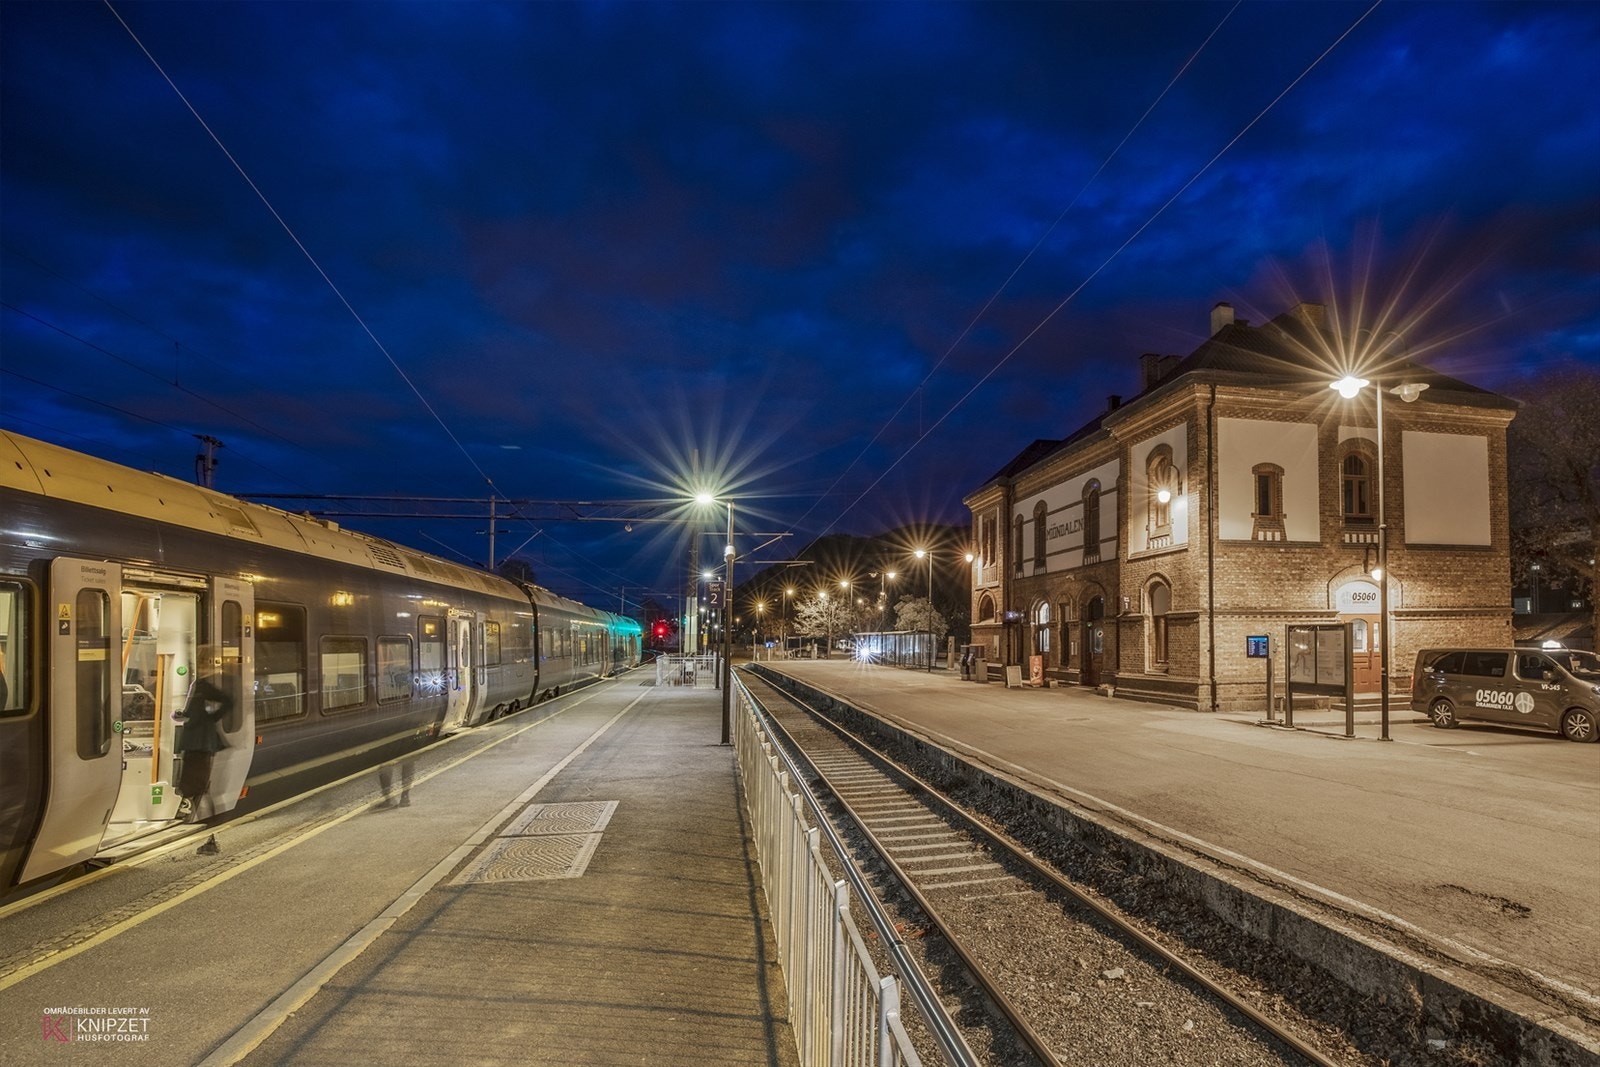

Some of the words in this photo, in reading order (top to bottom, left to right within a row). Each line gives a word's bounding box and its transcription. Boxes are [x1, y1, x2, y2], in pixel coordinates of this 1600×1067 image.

[710, 593, 718, 604] 2
[1352, 592, 1376, 601] 05060
[1475, 689, 1514, 705] 05060
